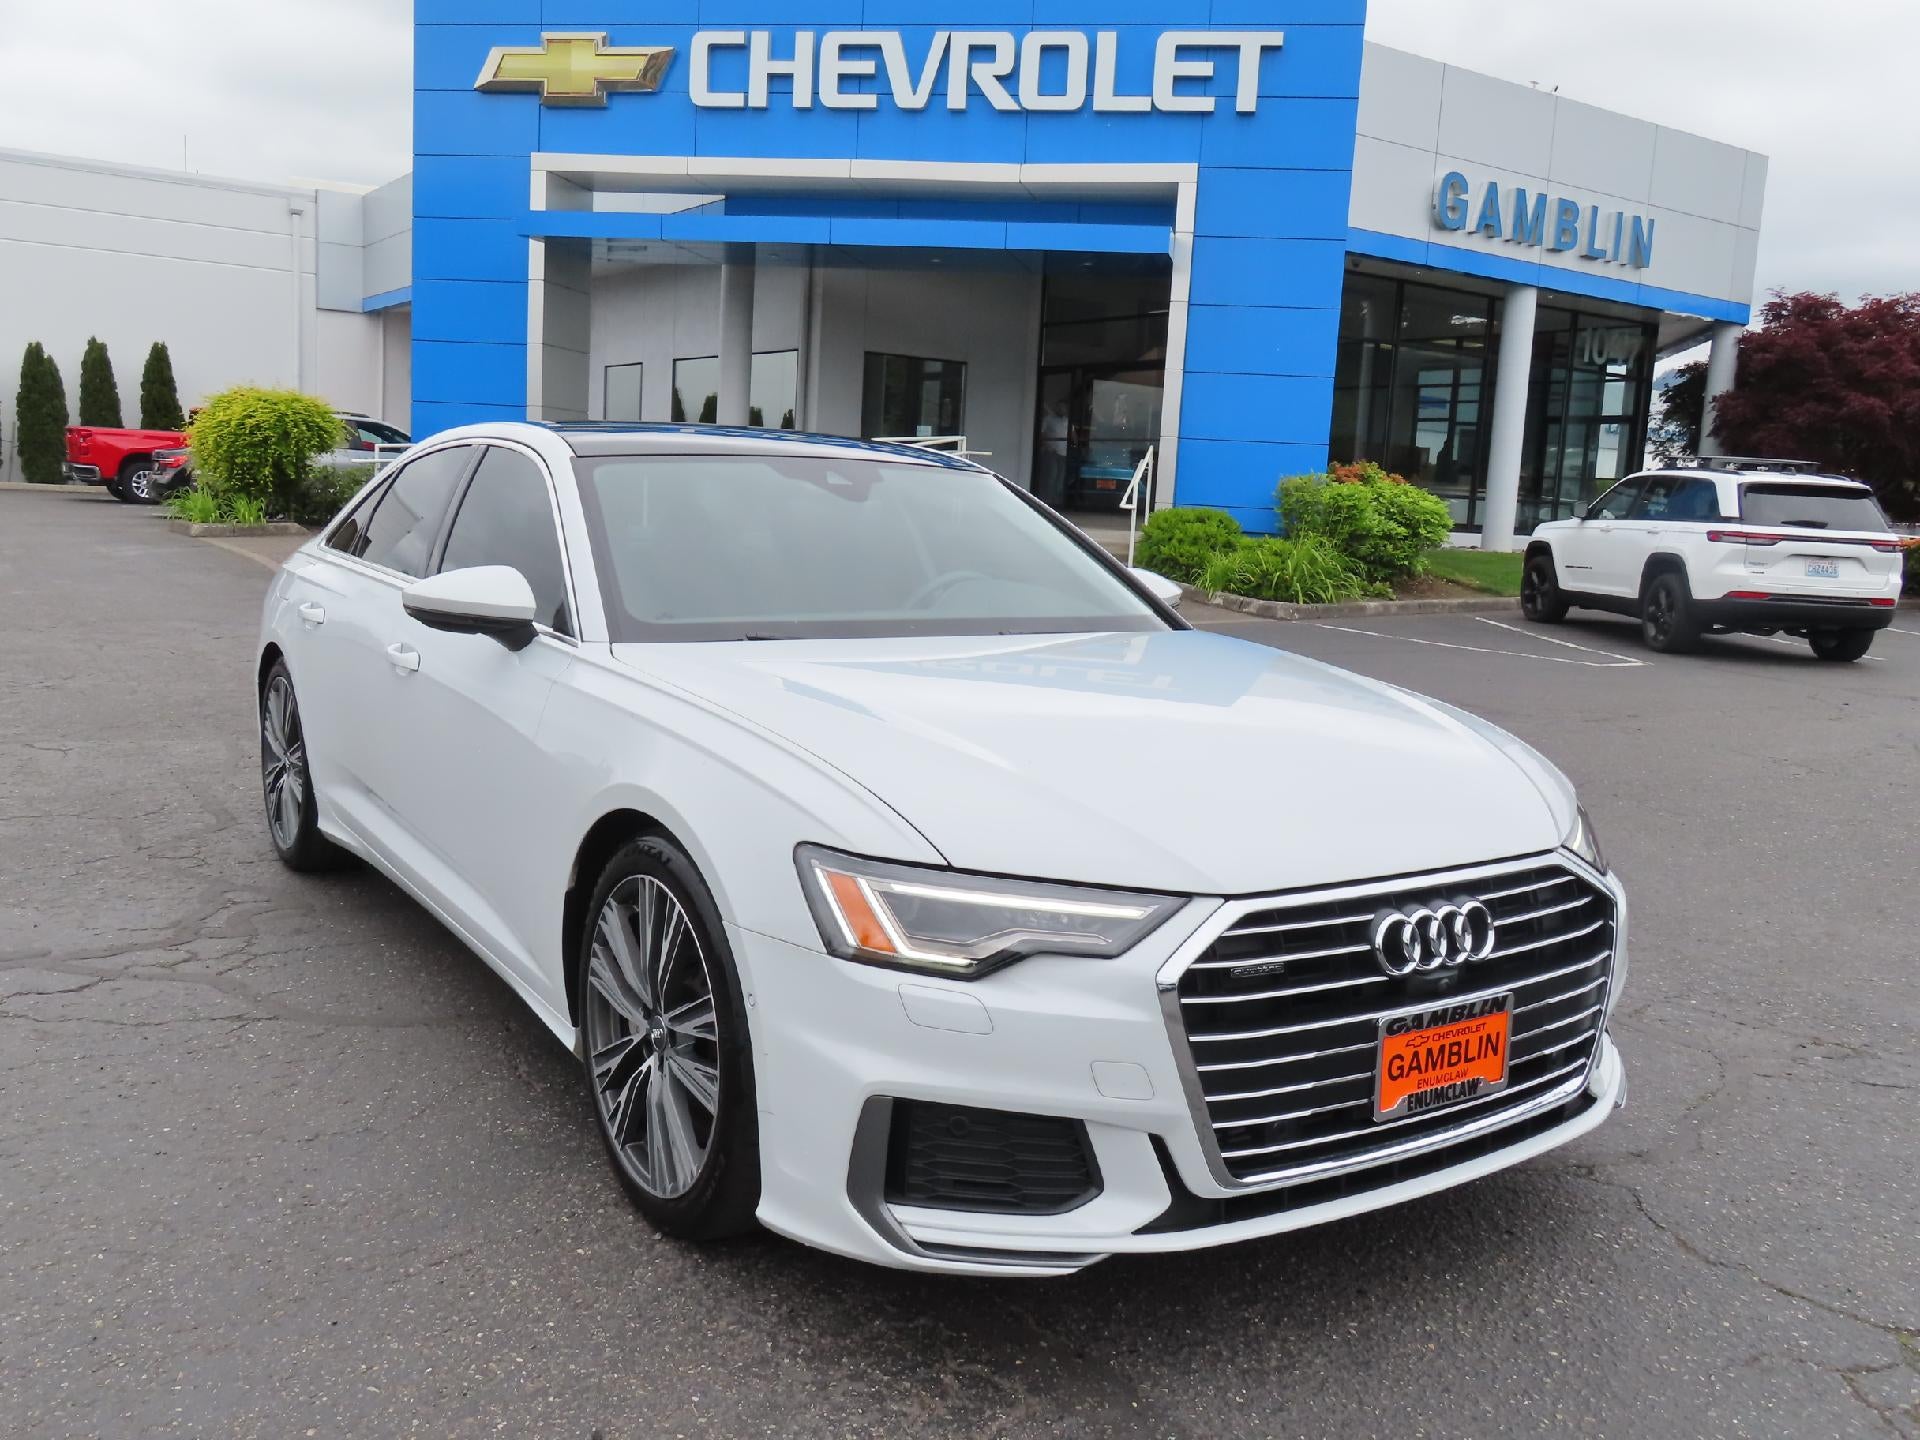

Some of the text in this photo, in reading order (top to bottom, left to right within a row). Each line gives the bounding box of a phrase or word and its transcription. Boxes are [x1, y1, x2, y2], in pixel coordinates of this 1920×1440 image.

[689, 31, 1284, 113] CHEVROLET
[1434, 171, 1655, 269] GAMBLIN
[1386, 995, 1507, 1036] GAMBLIN
[1432, 1022, 1487, 1042] CHEVROLET
[1388, 1031, 1500, 1081] GAMBLIN
[1407, 1077, 1480, 1112] ENUMCLAW
[1417, 1068, 1469, 1089] ENUMCLAW
